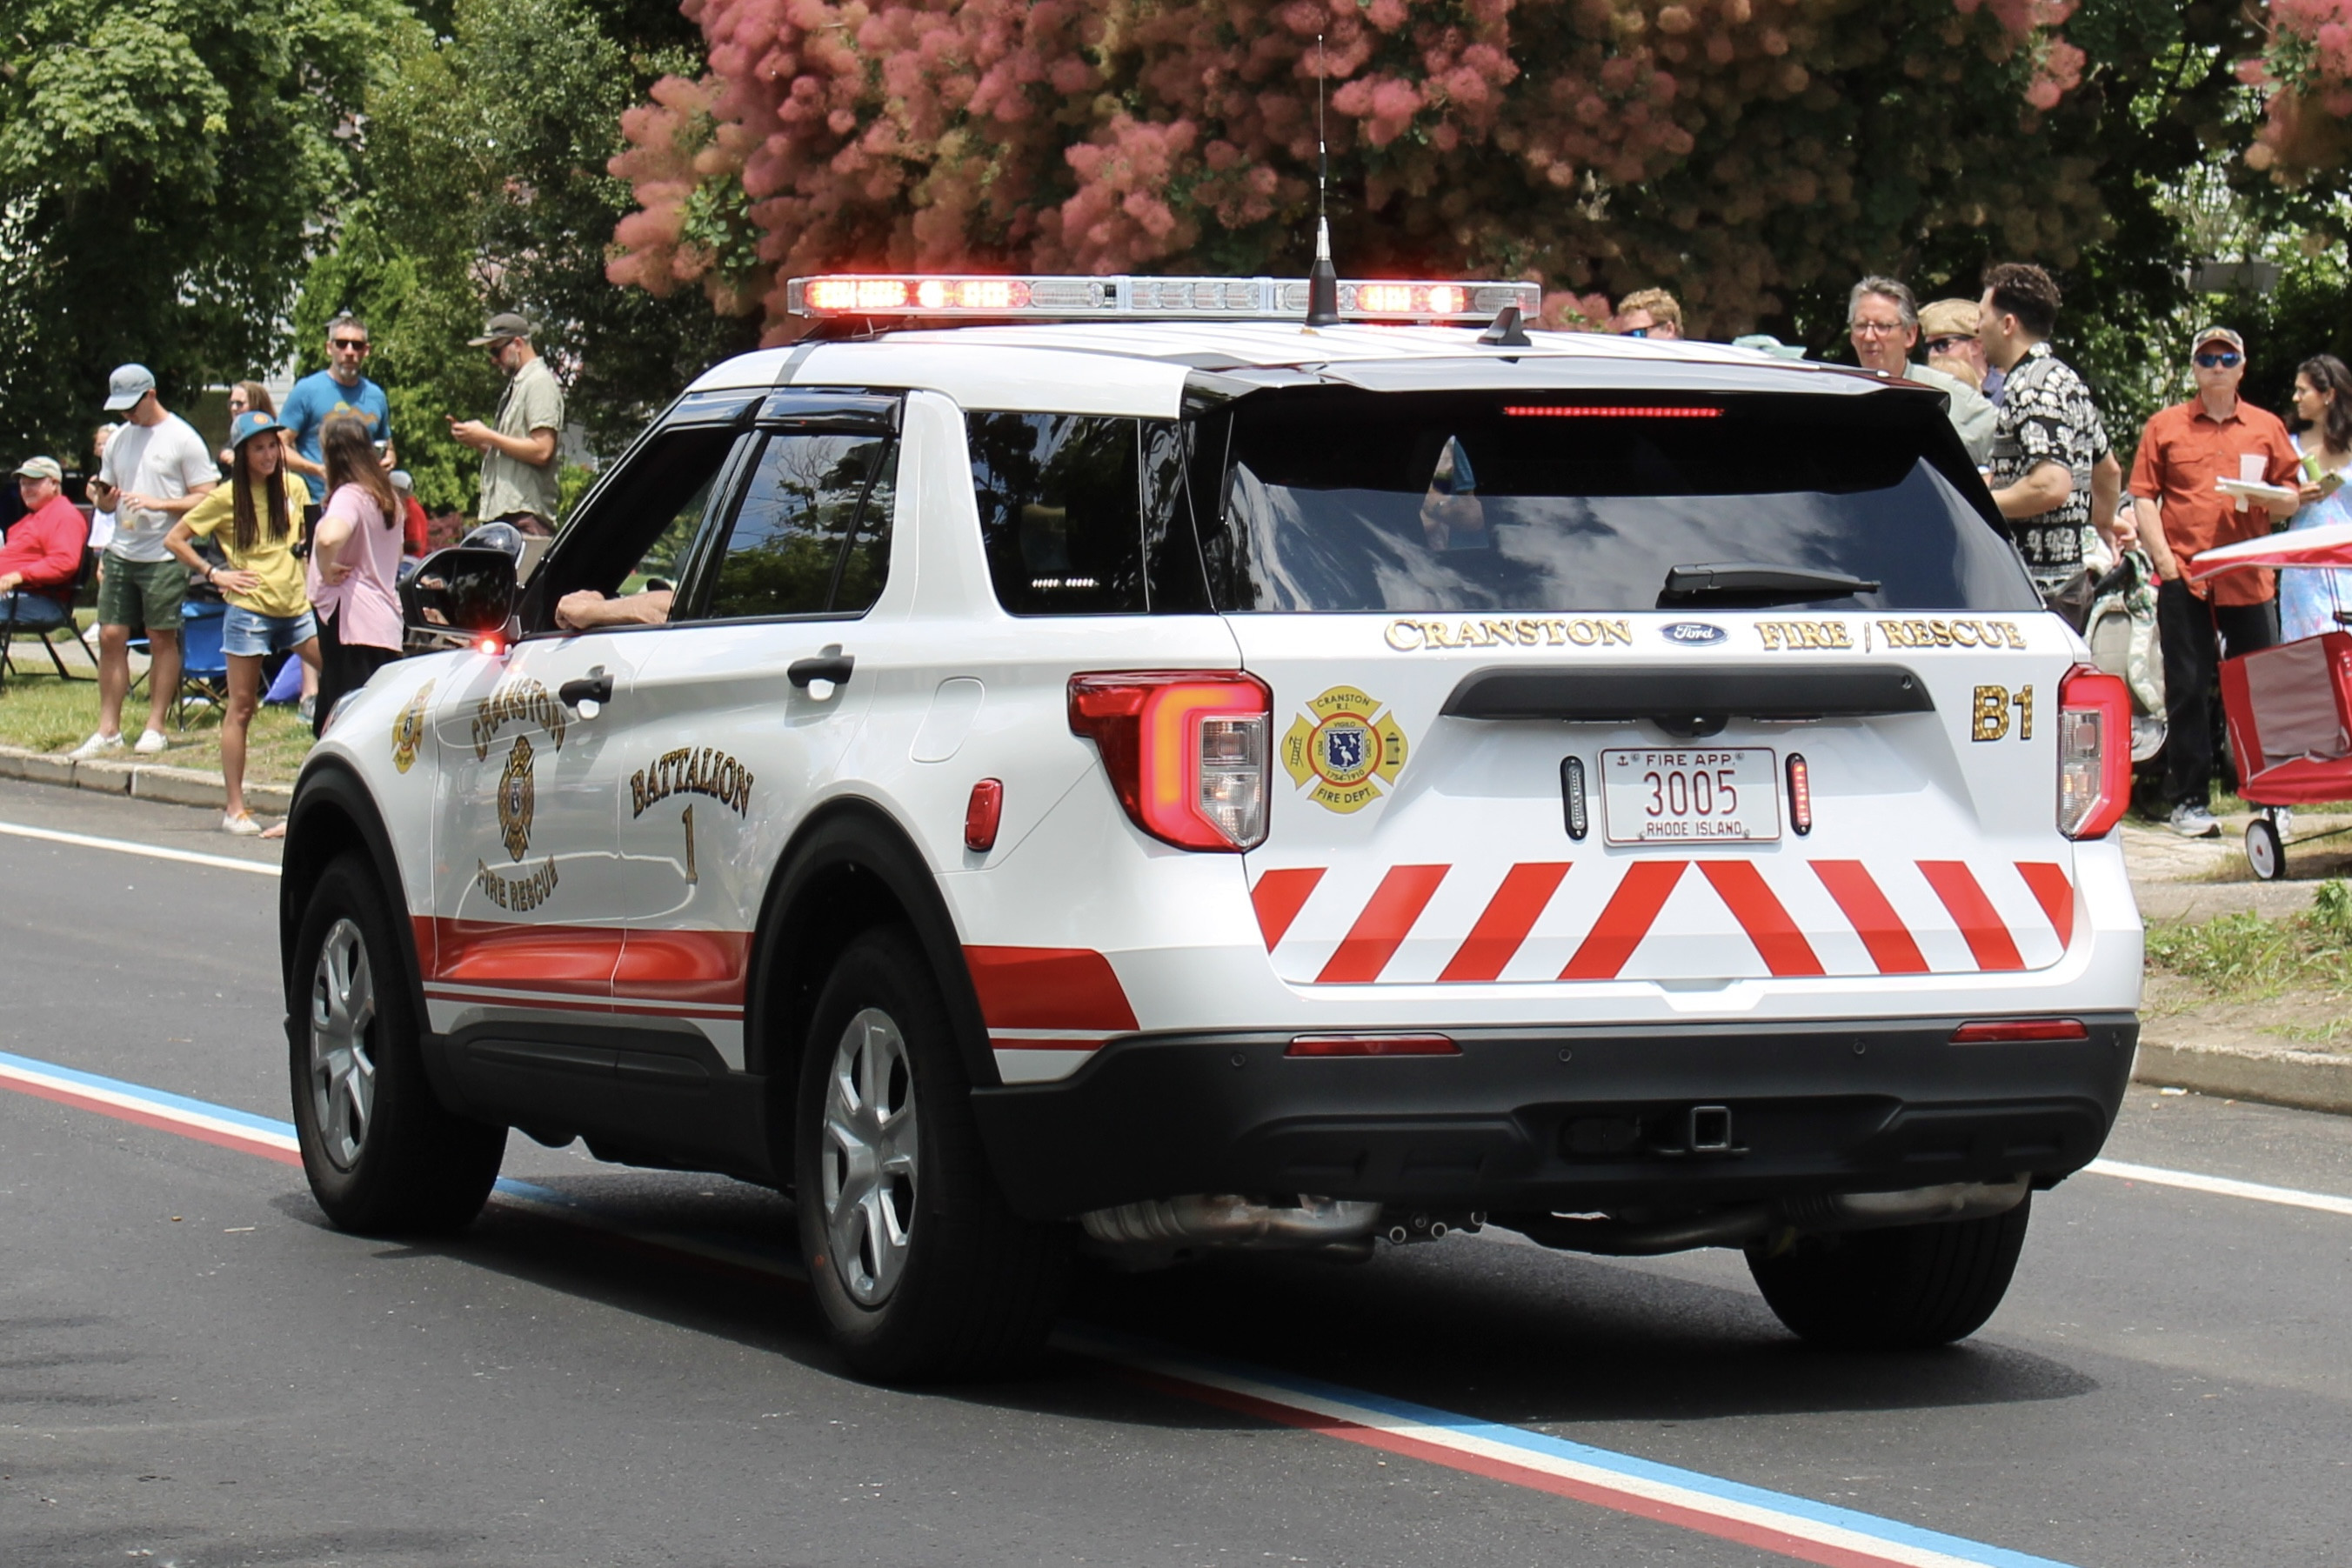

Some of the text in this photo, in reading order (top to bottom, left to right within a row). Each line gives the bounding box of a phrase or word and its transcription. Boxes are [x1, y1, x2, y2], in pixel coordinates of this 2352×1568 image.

[1384, 619, 1633, 651] CRANSTON
[1673, 624, 1715, 641] Ford
[1754, 621, 1854, 651] FIRE
[1877, 619, 2028, 651] RESCUE
[1317, 694, 1371, 708] CRANSTON
[1972, 684, 2033, 742] B1
[472, 678, 566, 763] CRANSTON
[1326, 770, 1365, 782] 1754-1910
[1647, 754, 1736, 766] FIRE APP.
[630, 746, 754, 820] BATTALION
[1317, 788, 1340, 804] FIRE
[1644, 770, 1737, 816] 3005
[682, 803, 698, 884] 1
[1647, 821, 1742, 836] RHODE ISLAND
[478, 853, 558, 912] FIRE RESCUE
